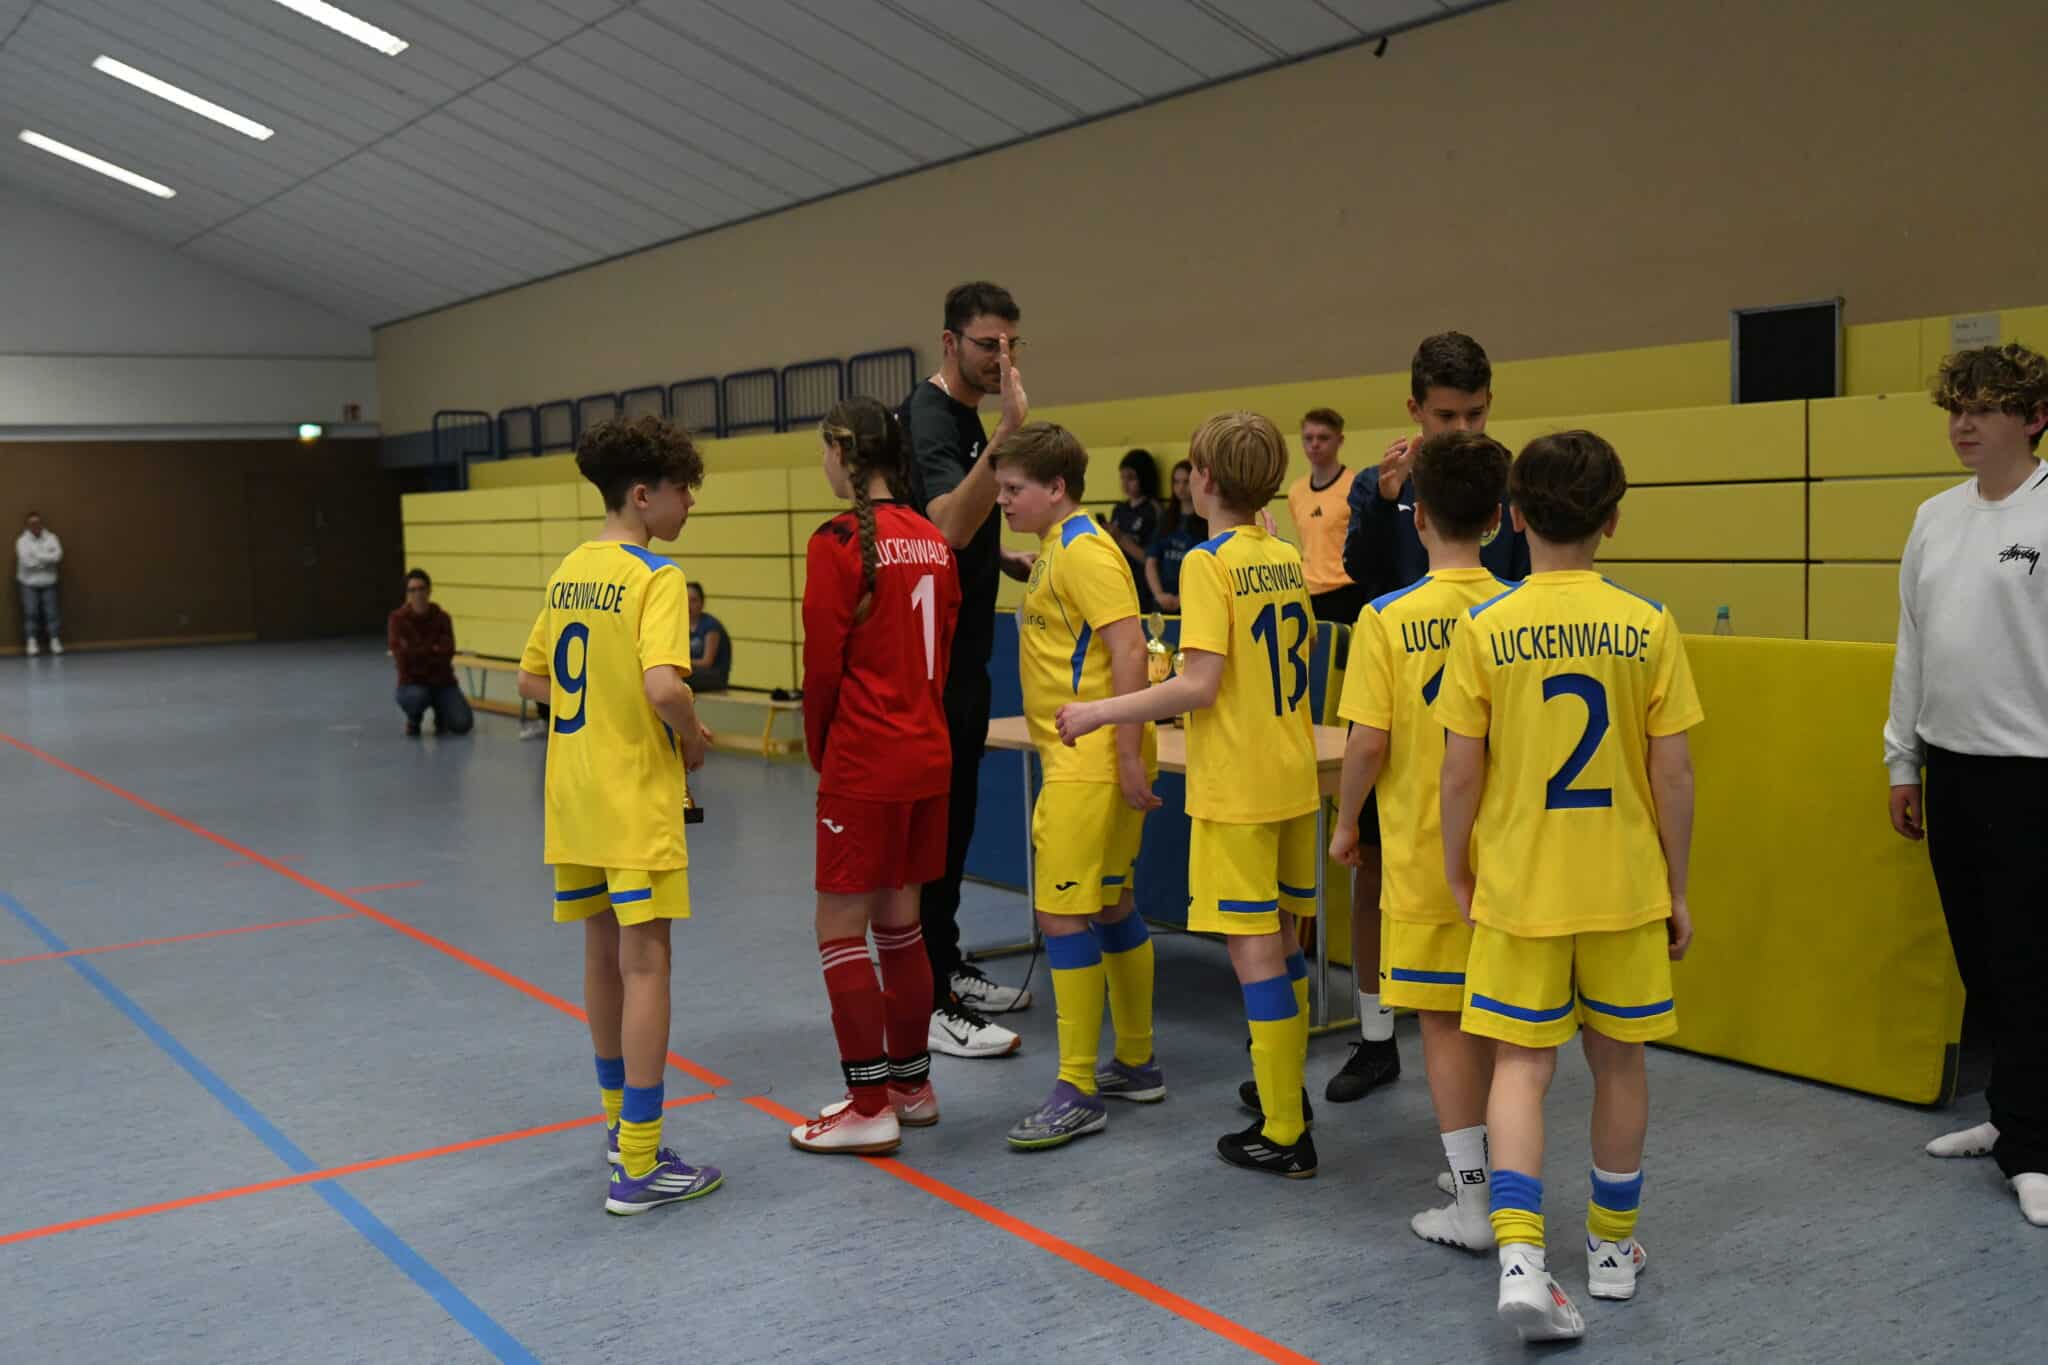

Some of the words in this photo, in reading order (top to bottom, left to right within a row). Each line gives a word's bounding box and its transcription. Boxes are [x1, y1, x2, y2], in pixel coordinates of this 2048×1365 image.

[549, 581, 626, 613] CKENWALDE
[911, 574, 935, 680] 1
[1490, 622, 1650, 666] LUCKENWALDE
[554, 621, 590, 734] 9
[1251, 601, 1309, 717] 13
[1542, 672, 1613, 810] 2
